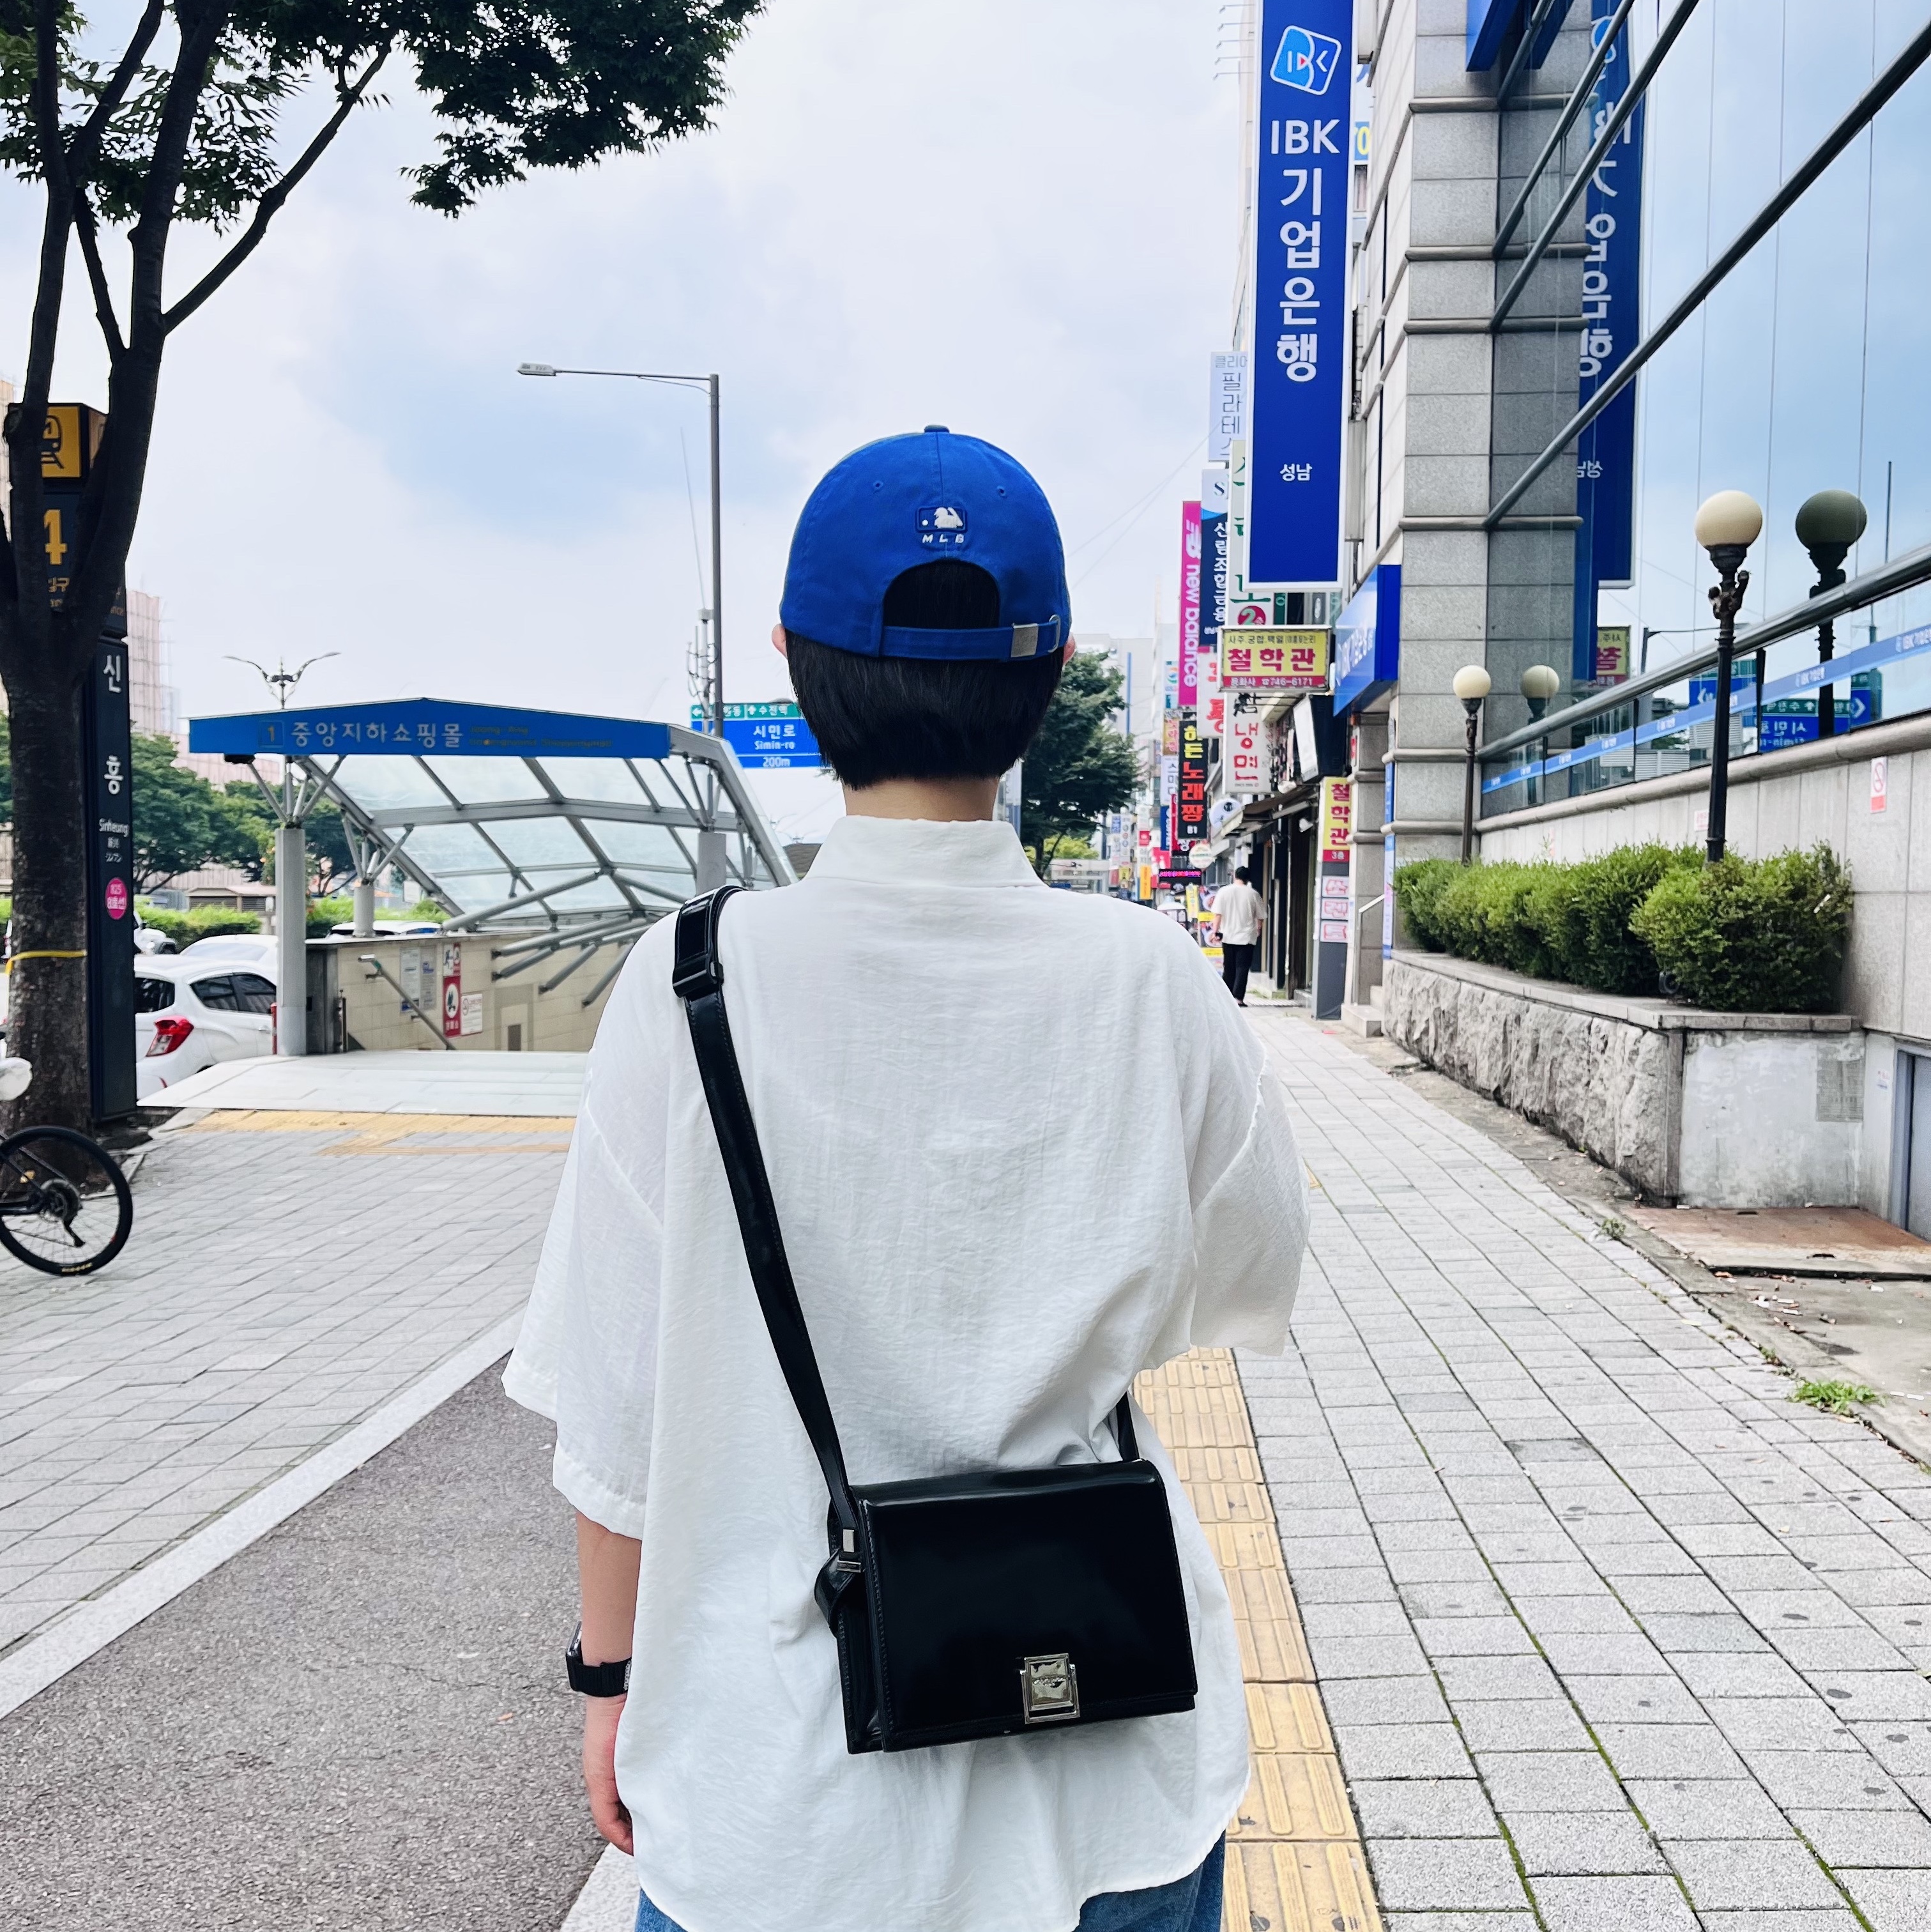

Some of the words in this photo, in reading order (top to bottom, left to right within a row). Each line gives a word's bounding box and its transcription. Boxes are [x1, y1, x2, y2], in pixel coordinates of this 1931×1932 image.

[1271, 119, 1340, 155] IBK
[1277, 168, 1322, 382] 기업은행
[1279, 463, 1313, 482] 성남
[922, 534, 964, 543] MLB
[1186, 564, 1200, 602] new
[1184, 607, 1200, 687] balance
[1228, 648, 1316, 672] 철학관
[267, 725, 276, 742] 1
[291, 721, 463, 749] 중앙지하쇼핑몰
[753, 724, 796, 739] 시민로
[754, 740, 796, 750] Simin-ro
[1233, 723, 1259, 781] 냉면
[763, 756, 791, 767] 200m
[99, 818, 129, 838] Sinheung
[1330, 783, 1350, 847] 철학관
